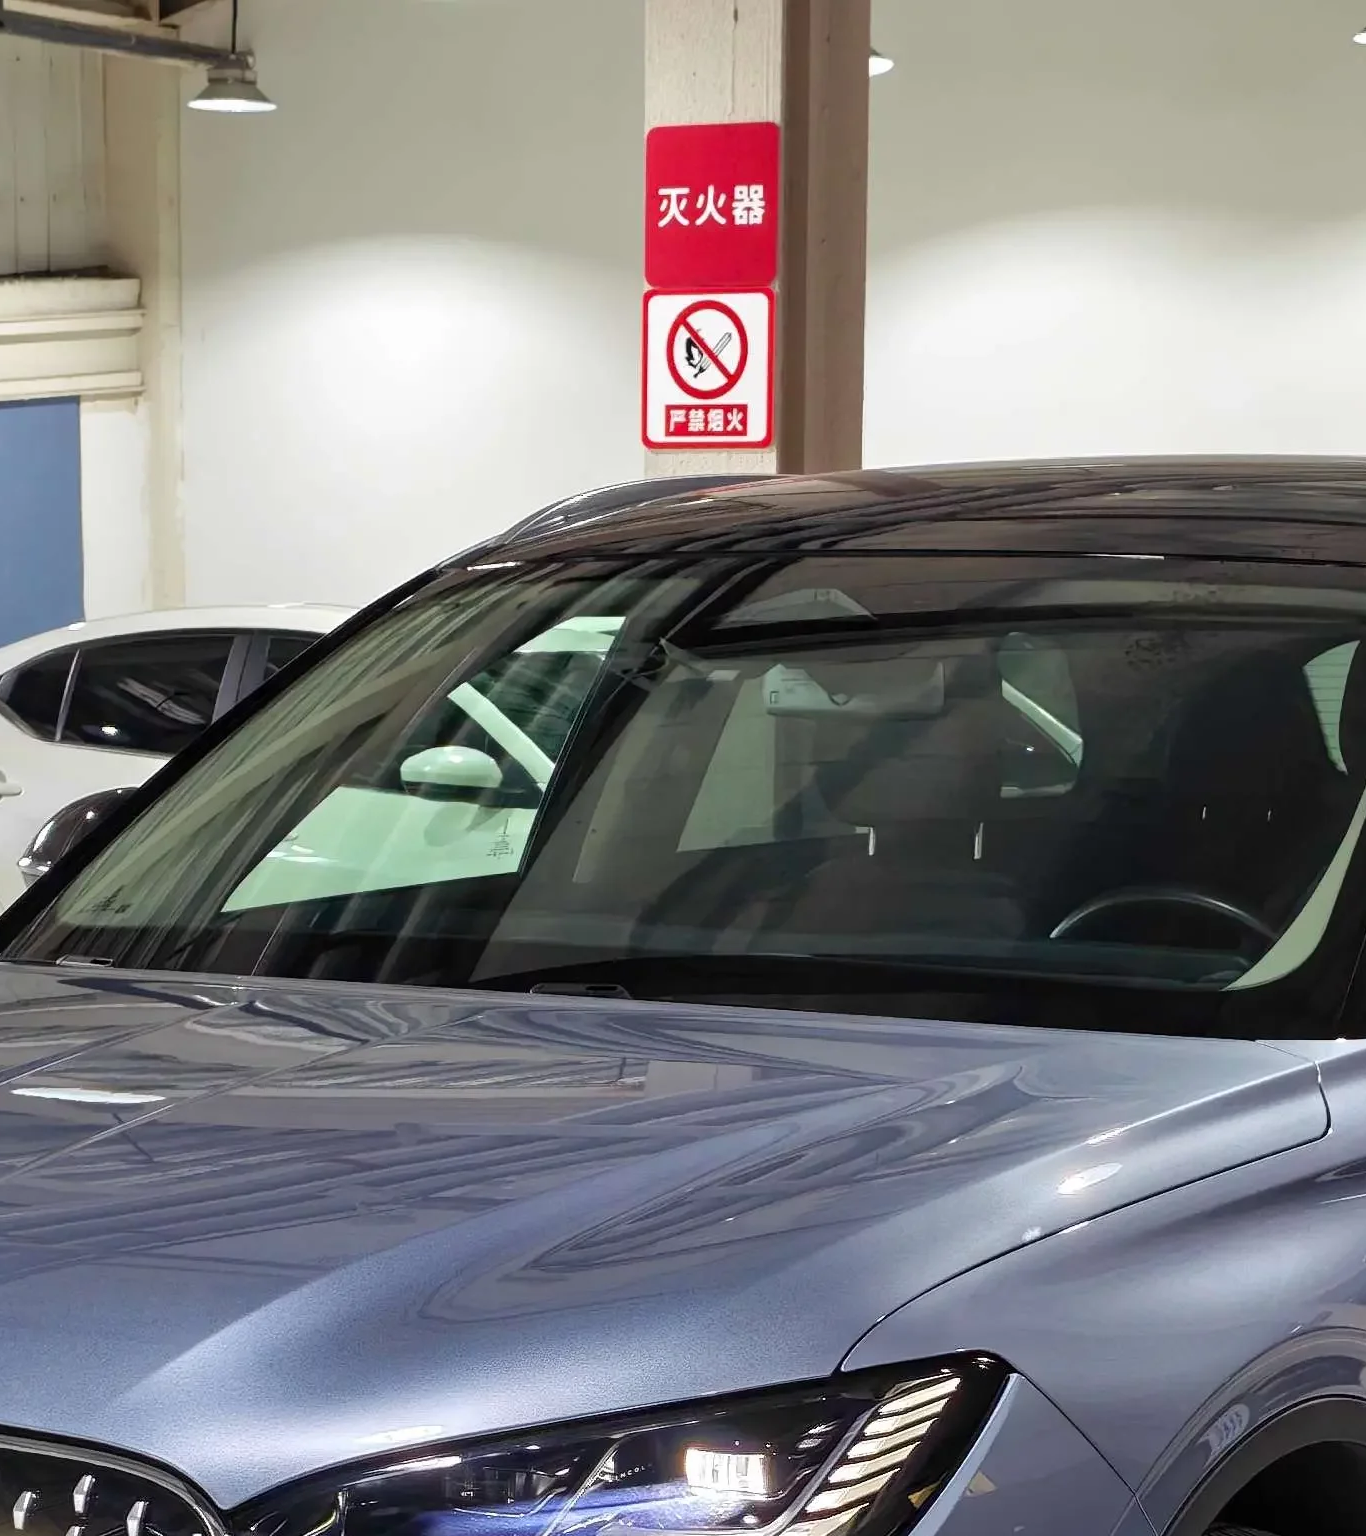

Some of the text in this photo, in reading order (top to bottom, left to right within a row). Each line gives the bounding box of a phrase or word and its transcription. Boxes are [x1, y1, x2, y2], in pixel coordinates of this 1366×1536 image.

[657, 184, 766, 227] 灭火器
[669, 408, 744, 432] 严禁烟火
